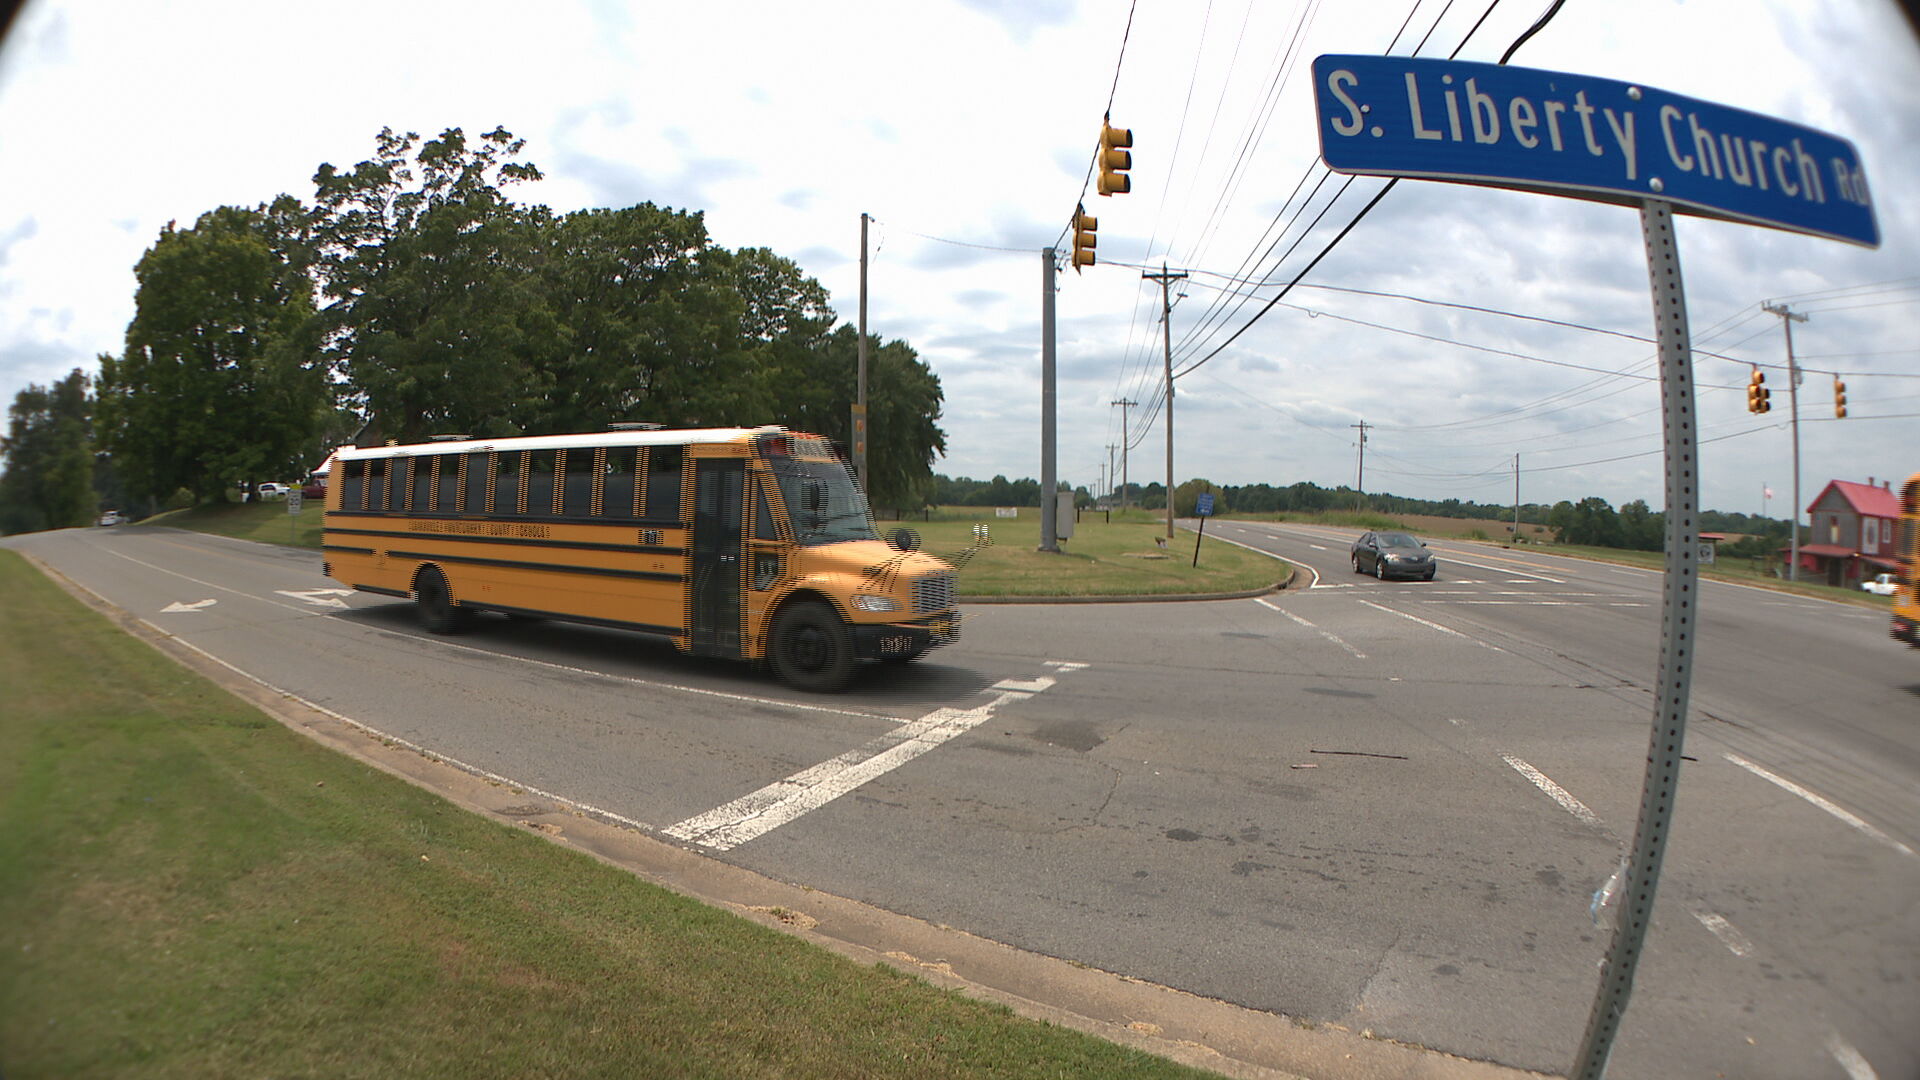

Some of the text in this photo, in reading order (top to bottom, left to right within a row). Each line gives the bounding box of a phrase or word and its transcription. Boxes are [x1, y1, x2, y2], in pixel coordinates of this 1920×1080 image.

[1327, 69, 1869, 206] S. Liberty Church Rd
